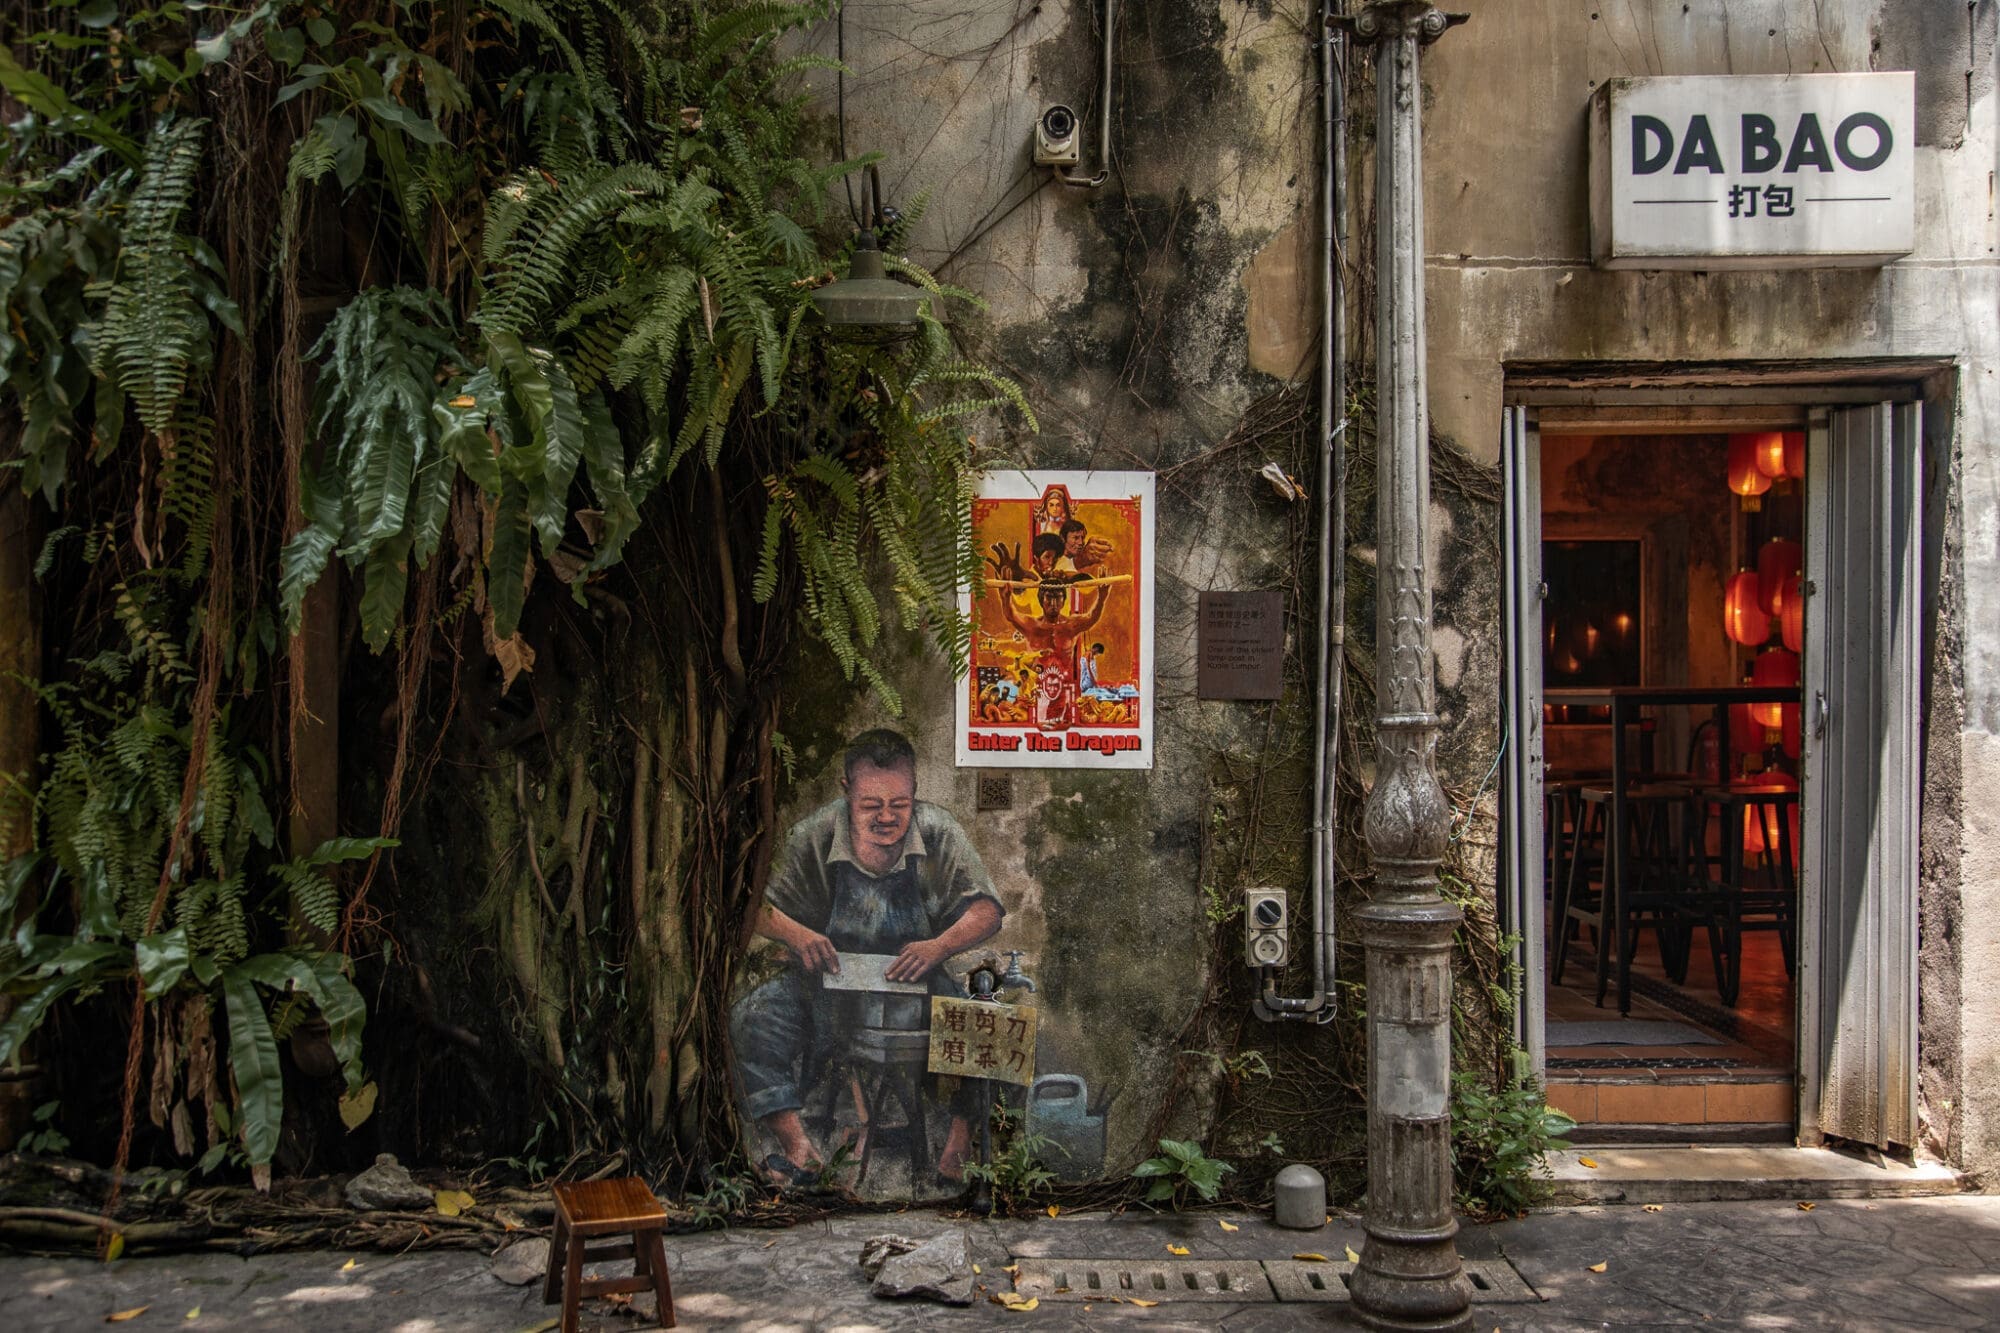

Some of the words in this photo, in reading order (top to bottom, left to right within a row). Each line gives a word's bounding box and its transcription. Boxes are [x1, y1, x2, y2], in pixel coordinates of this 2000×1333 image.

[1631, 114, 1725, 175] DA
[1741, 111, 1894, 174] BAO
[1728, 184, 1795, 218] 打包
[968, 731, 1022, 752] Enter
[1024, 732, 1062, 752] The
[1066, 732, 1141, 756] Dragon
[942, 1037, 1026, 1073] 磨菜刀
